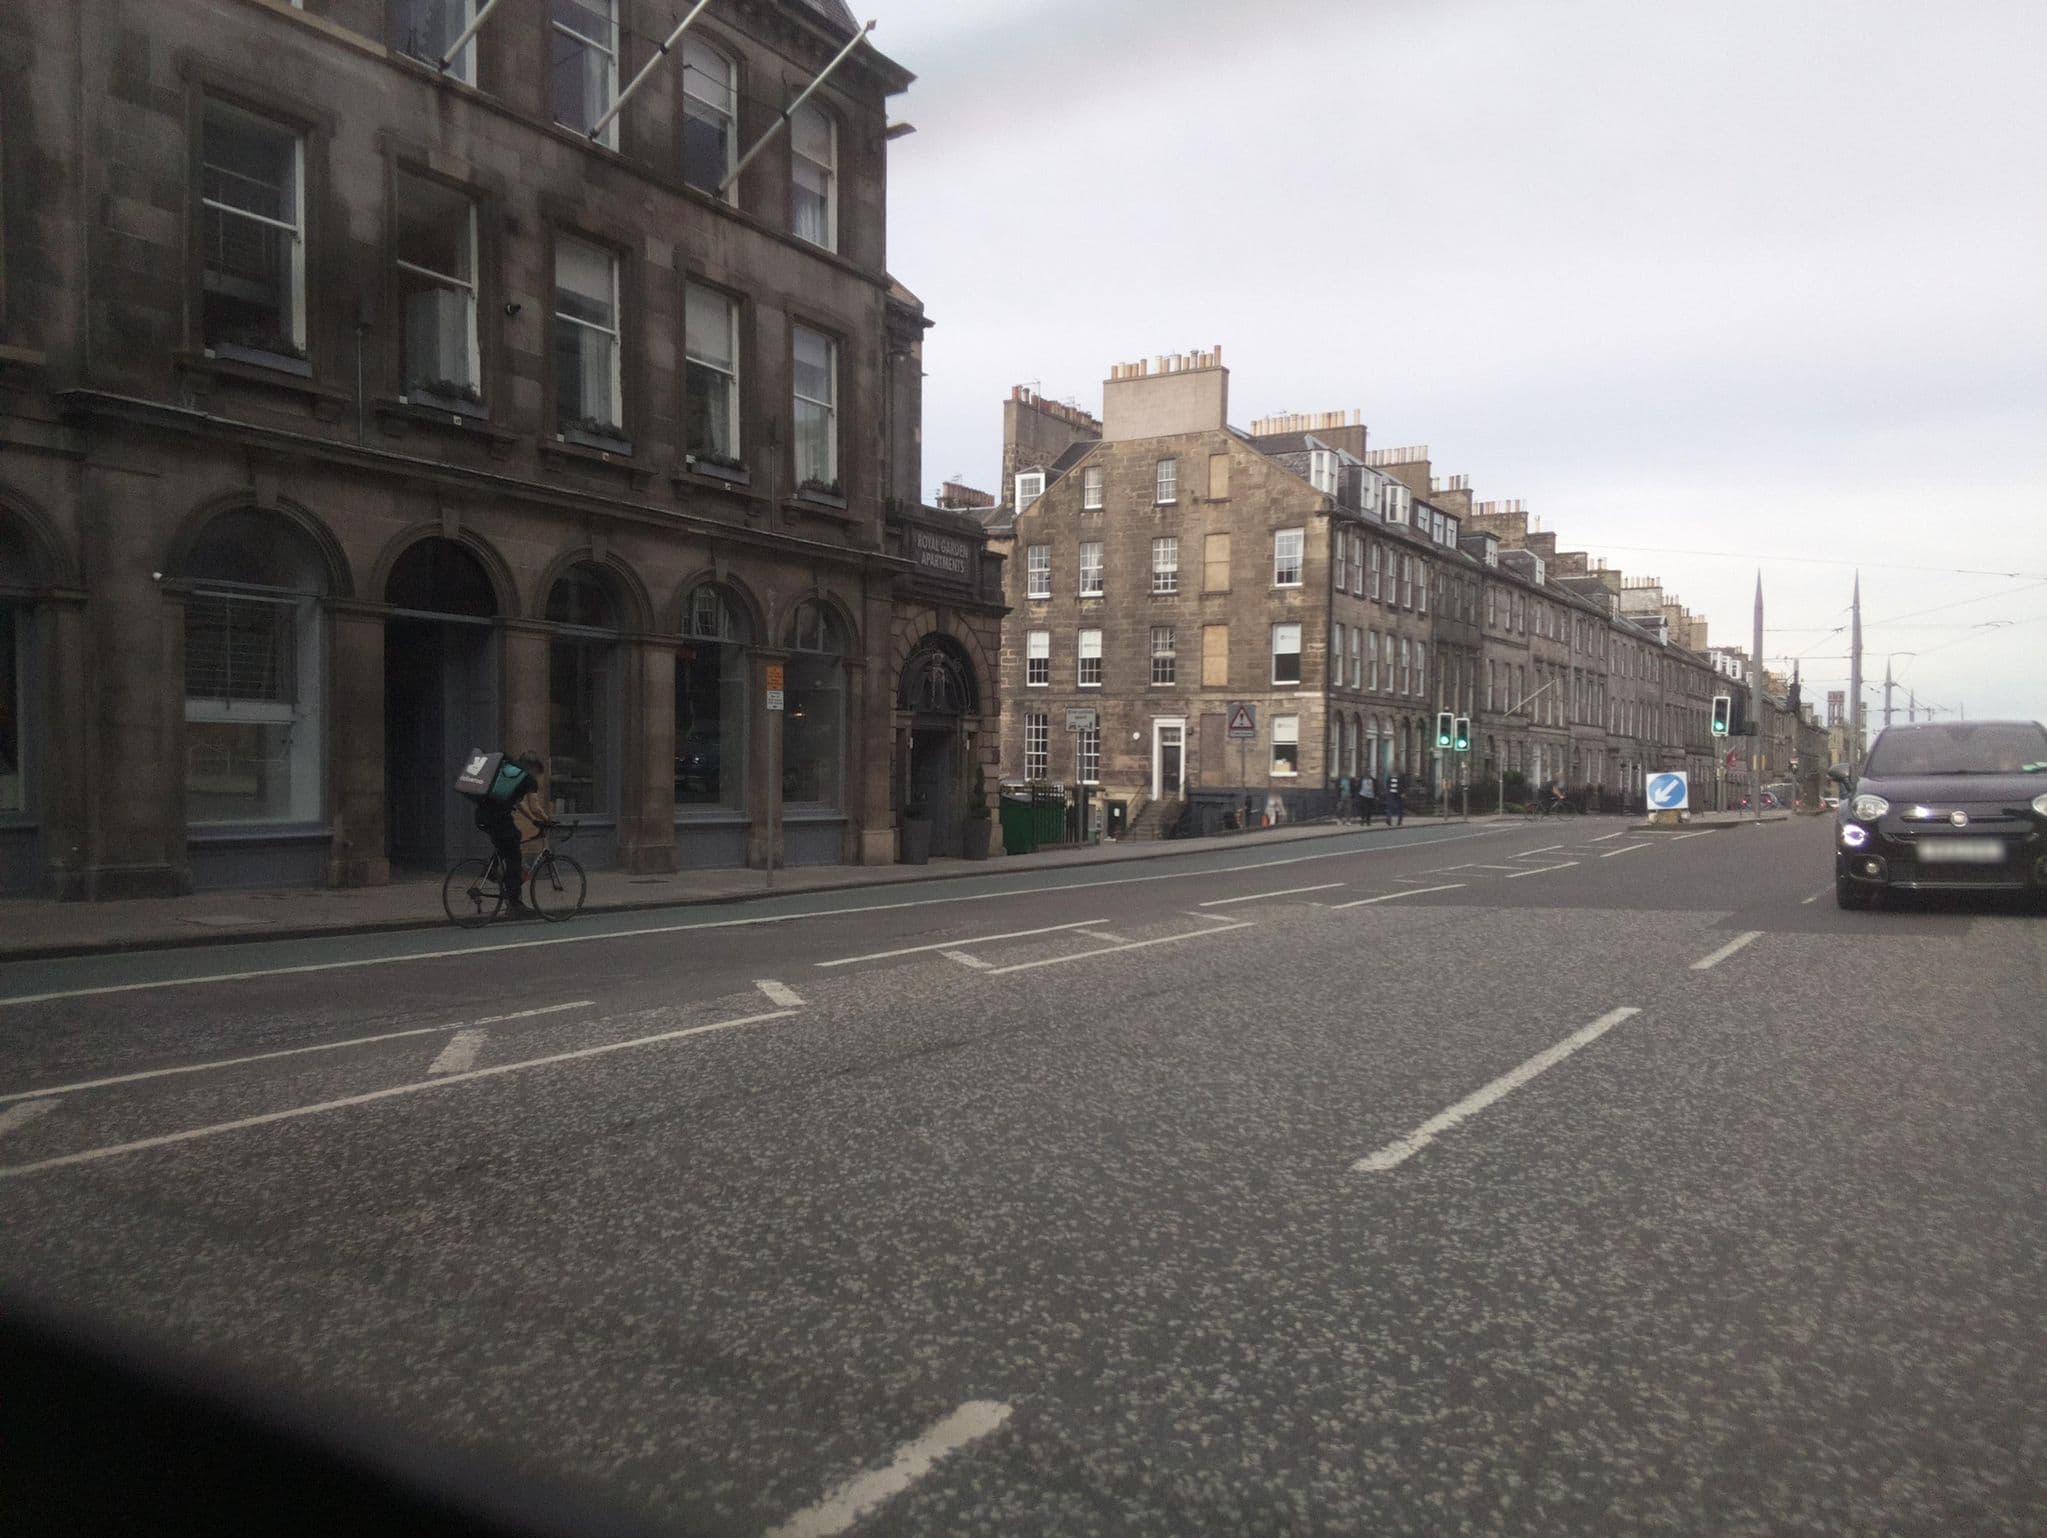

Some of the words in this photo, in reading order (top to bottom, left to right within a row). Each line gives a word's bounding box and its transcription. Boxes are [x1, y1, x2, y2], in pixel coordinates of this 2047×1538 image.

[917, 534, 940, 552] ROYAL
[941, 540, 969, 559] GARDEN
[921, 552, 965, 573] APARTMENTS
